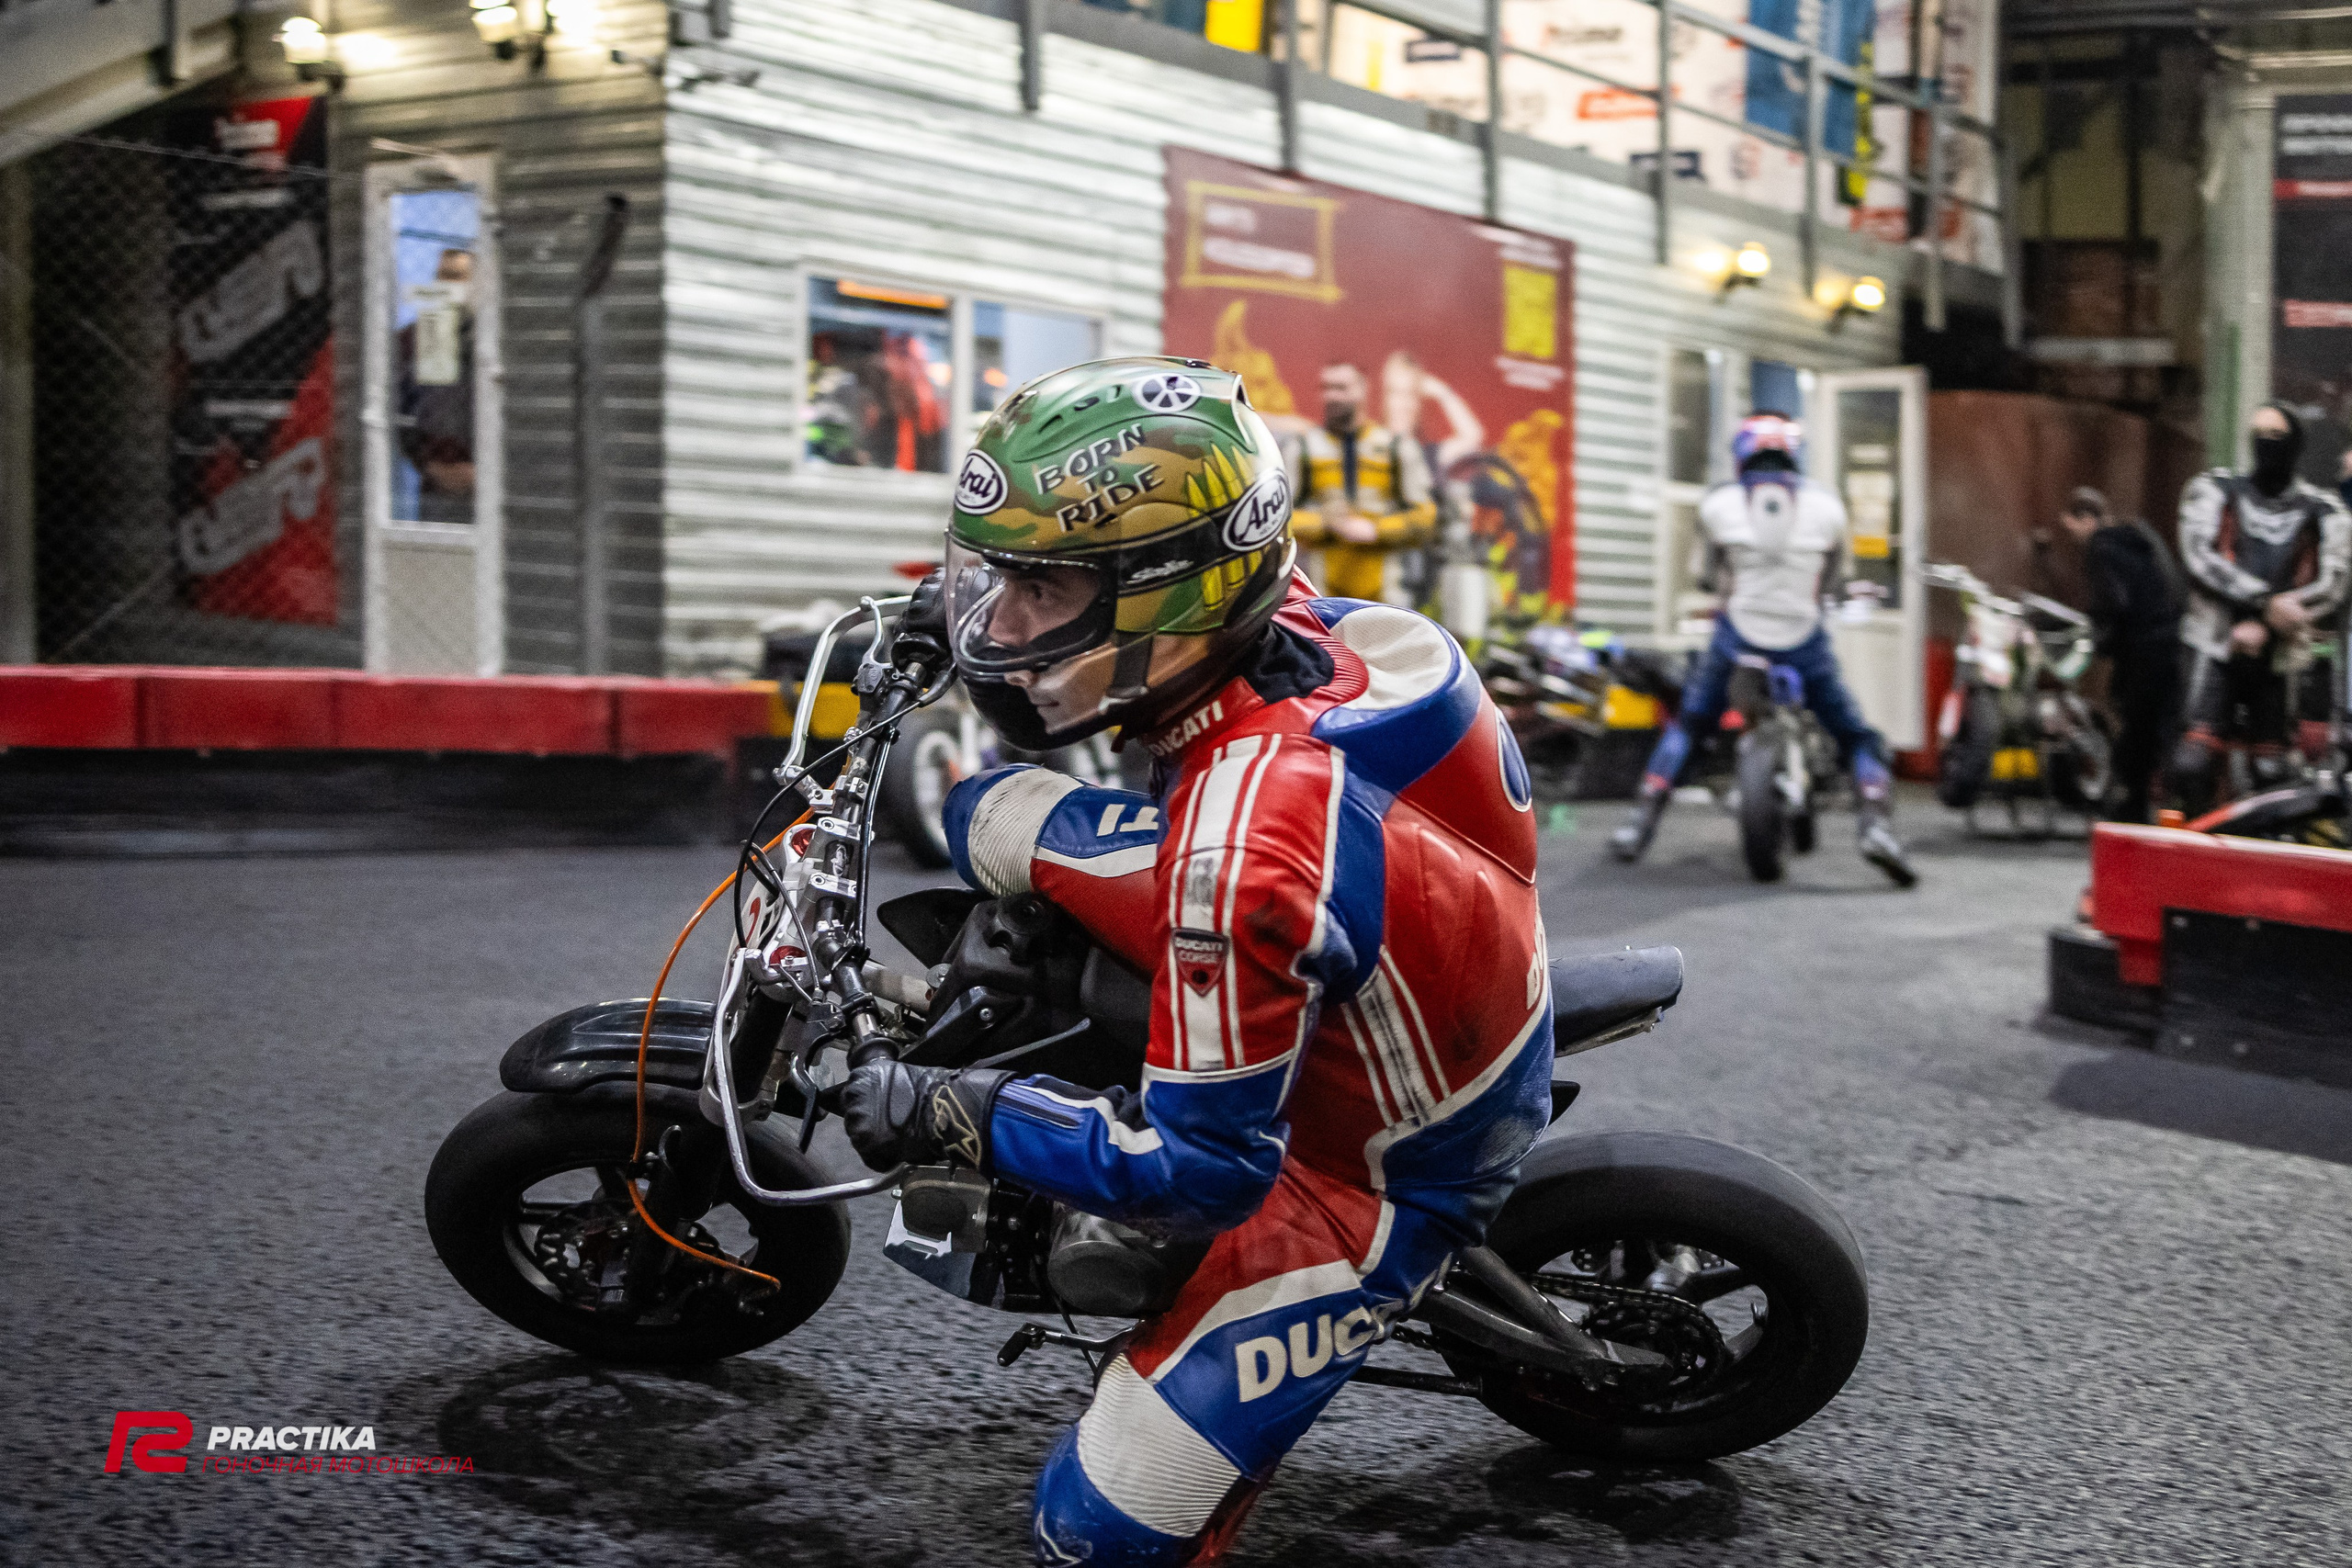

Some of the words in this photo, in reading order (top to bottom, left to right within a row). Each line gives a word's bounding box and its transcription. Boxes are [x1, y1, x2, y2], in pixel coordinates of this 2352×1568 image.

[1035, 423, 1147, 495] BORN
[1076, 465, 1119, 494] TO
[1057, 463, 1165, 533] RIDE
